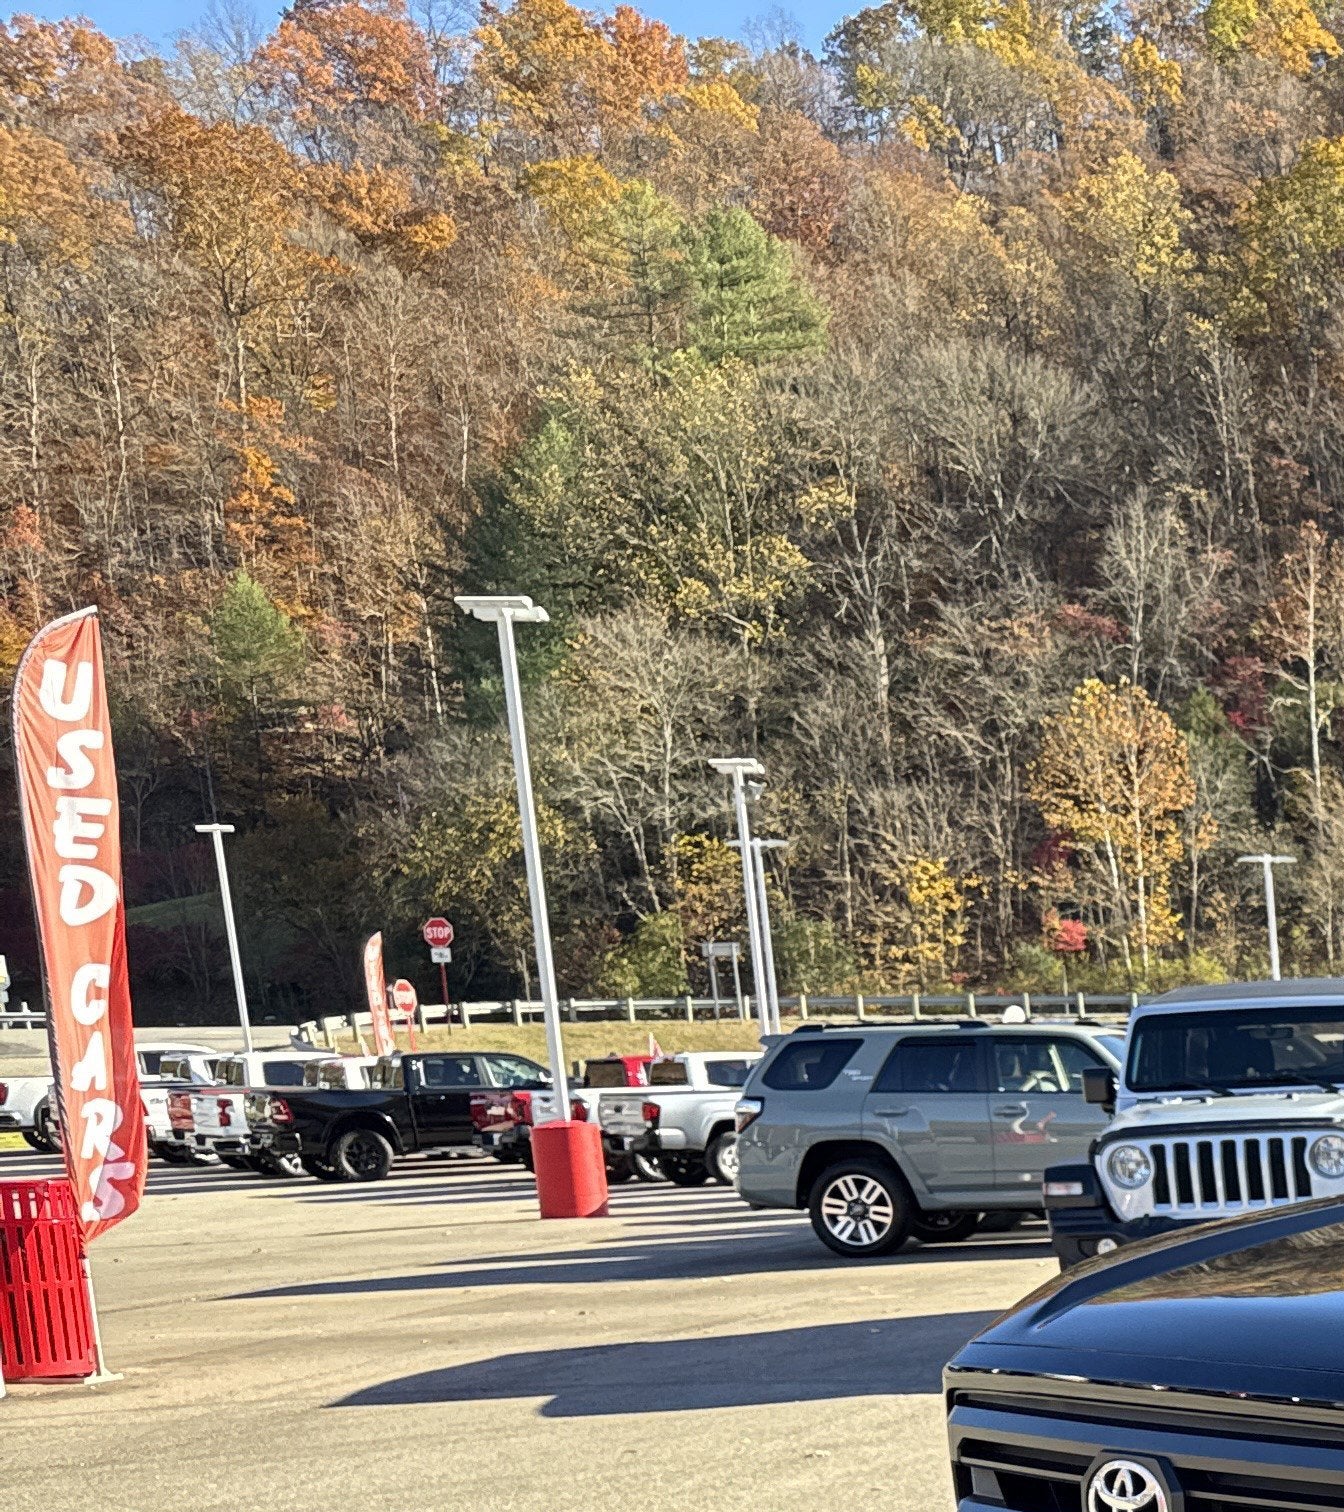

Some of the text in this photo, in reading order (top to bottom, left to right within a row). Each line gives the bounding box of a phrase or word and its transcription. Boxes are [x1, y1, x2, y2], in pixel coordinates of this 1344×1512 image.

[39, 660, 133, 1222] USED CARS
[426, 926, 451, 939] STOP
